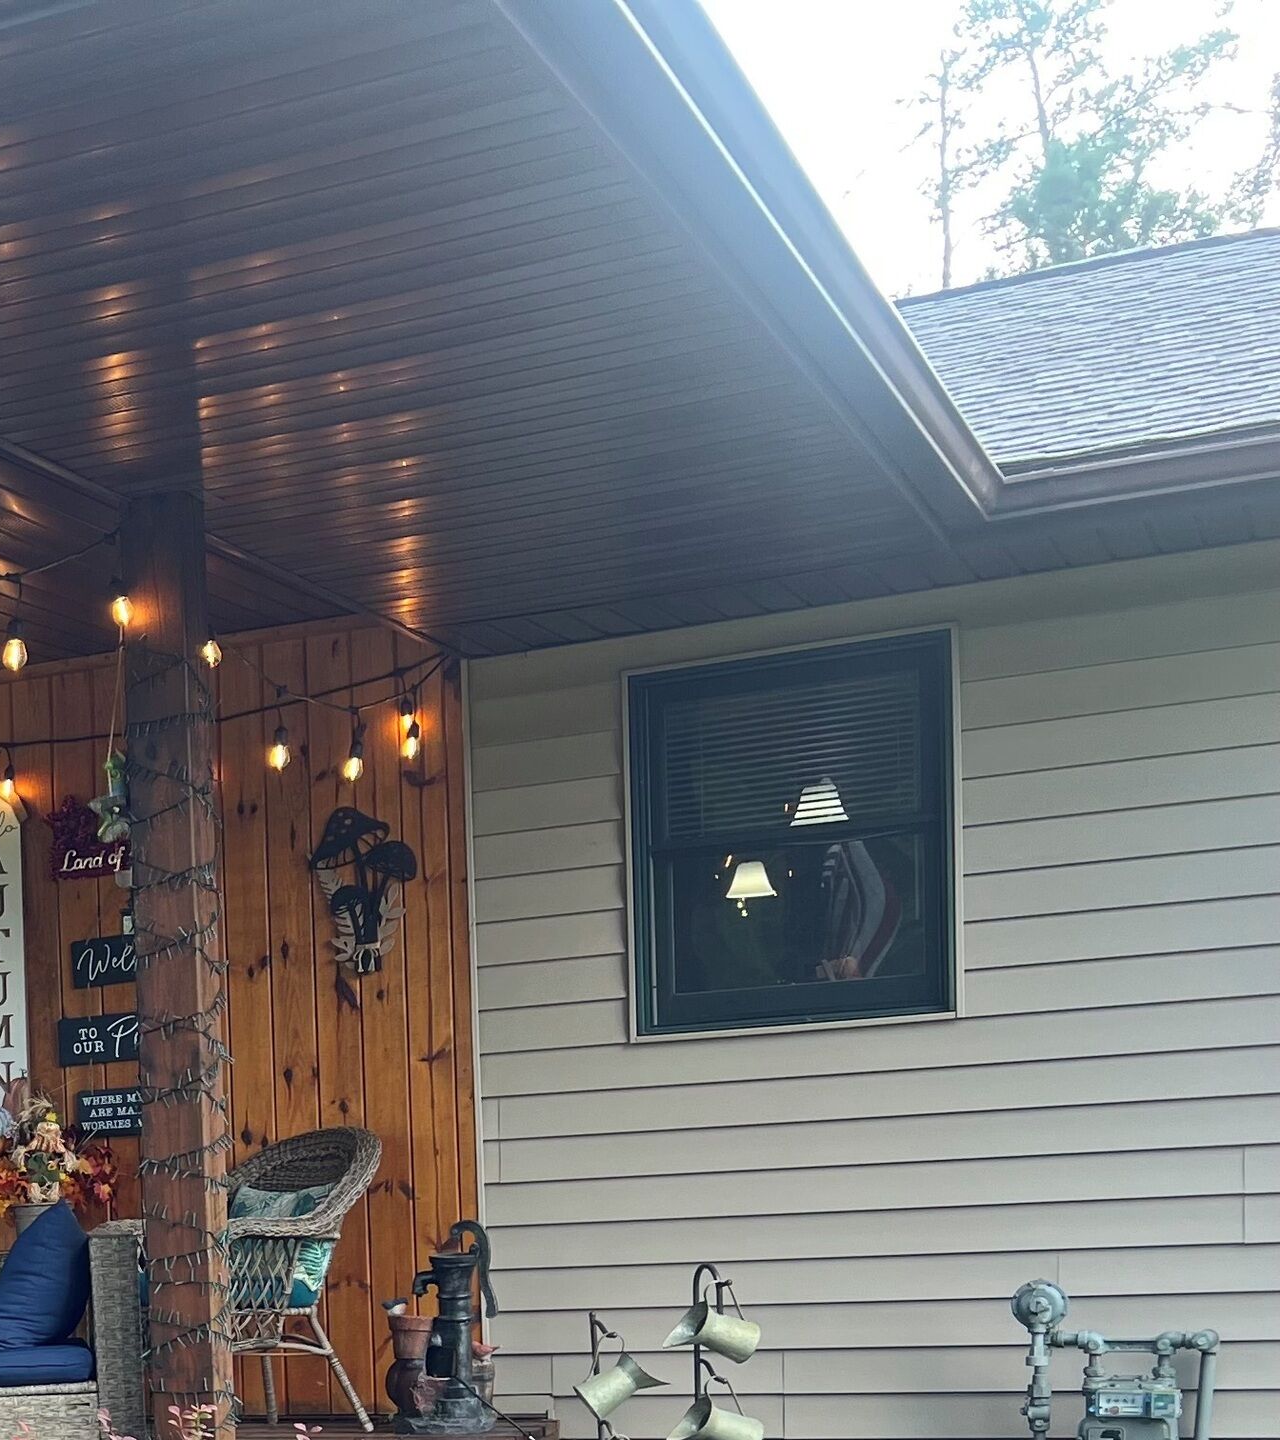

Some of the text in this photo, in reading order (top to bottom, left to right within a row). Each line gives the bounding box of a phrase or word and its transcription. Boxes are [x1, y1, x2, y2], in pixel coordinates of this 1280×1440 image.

[59, 846, 126, 872] Land of
[76, 943, 136, 981] Wel
[78, 1027, 98, 1041] TO
[73, 1040, 105, 1055] OUR
[81, 1094, 123, 1107] WHERE
[89, 1106, 142, 1118] ARE MA
[81, 1118, 132, 1131] WORRIES
